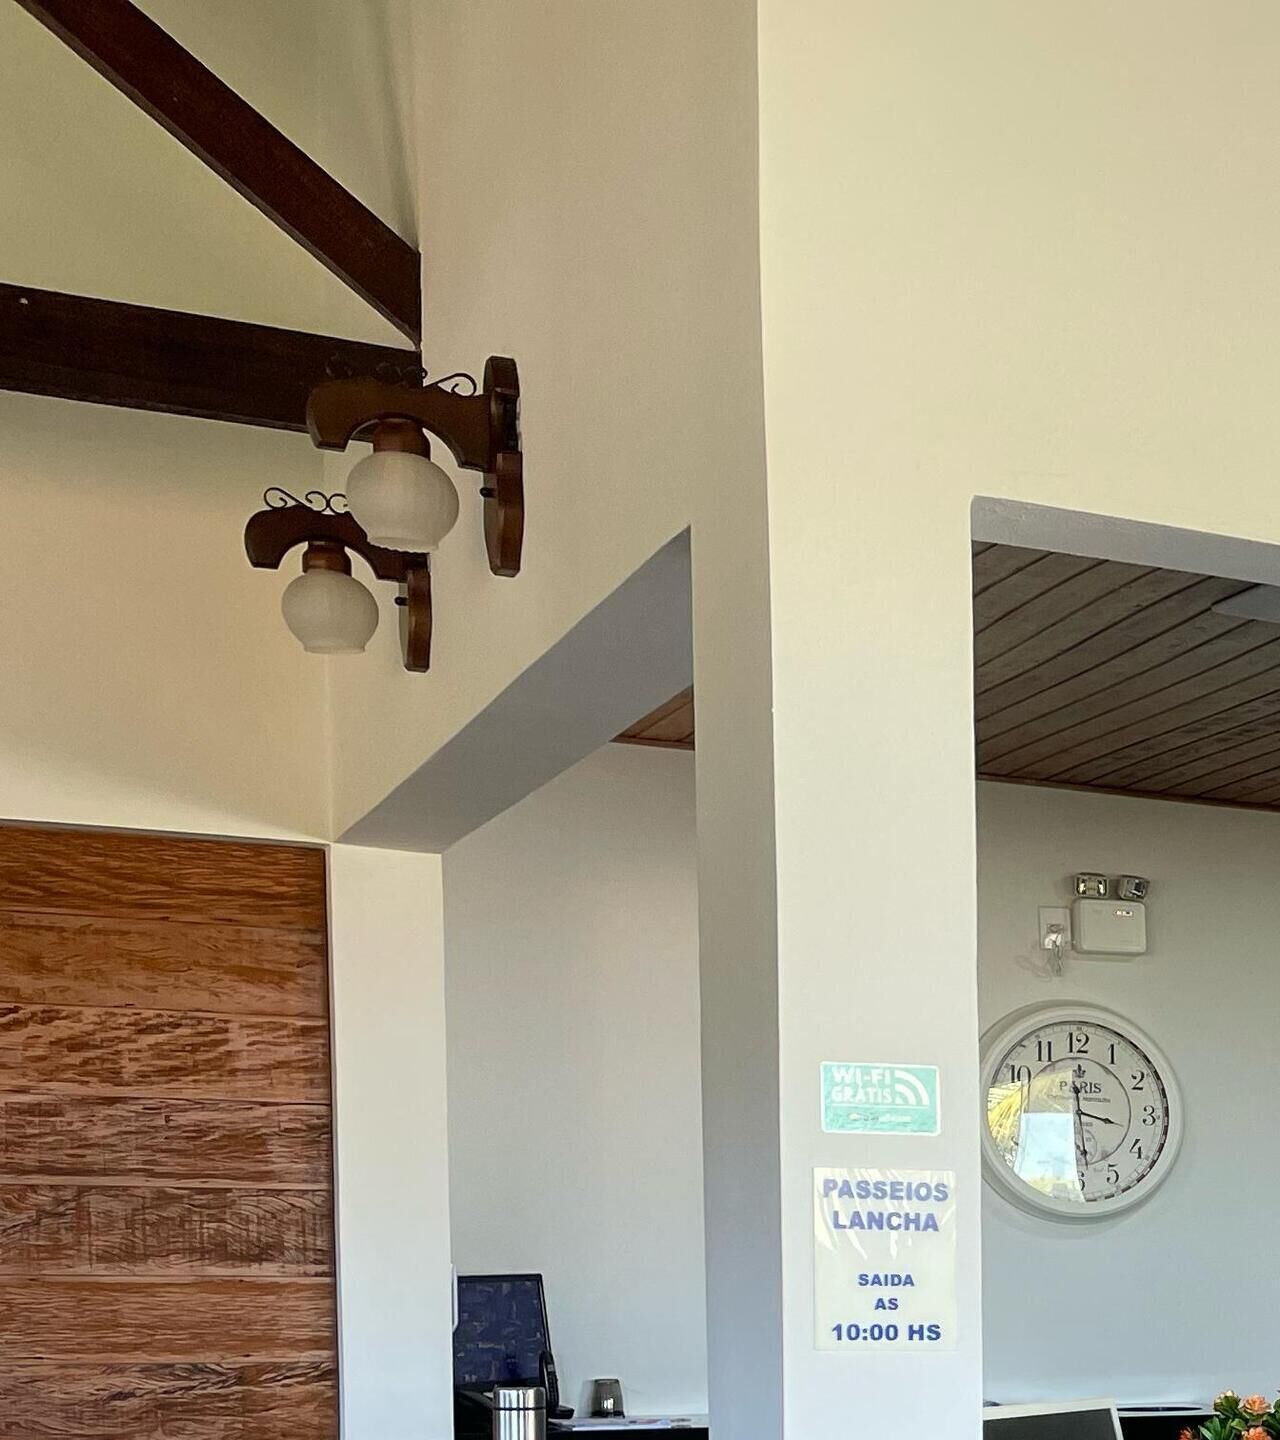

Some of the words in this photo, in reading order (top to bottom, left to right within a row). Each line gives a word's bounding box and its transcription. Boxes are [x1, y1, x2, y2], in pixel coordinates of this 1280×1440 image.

[1037, 1040, 1052, 1062] 11
[1066, 1032, 1089, 1054] 12
[1108, 1043, 1116, 1065] 1
[831, 1066, 891, 1085] WI-FI
[1010, 1064, 1031, 1085] 10
[1131, 1069, 1145, 1090] 2
[1142, 1105, 1156, 1126] 3
[1129, 1138, 1143, 1159] 4
[1106, 1164, 1120, 1184] 5
[823, 1179, 948, 1202] PASSEIOS
[832, 1211, 939, 1232] LANCHA
[857, 1273, 915, 1287] SAIDA
[874, 1298, 899, 1311] AS
[832, 1323, 899, 1341] 10:00
[908, 1324, 942, 1341] HS
